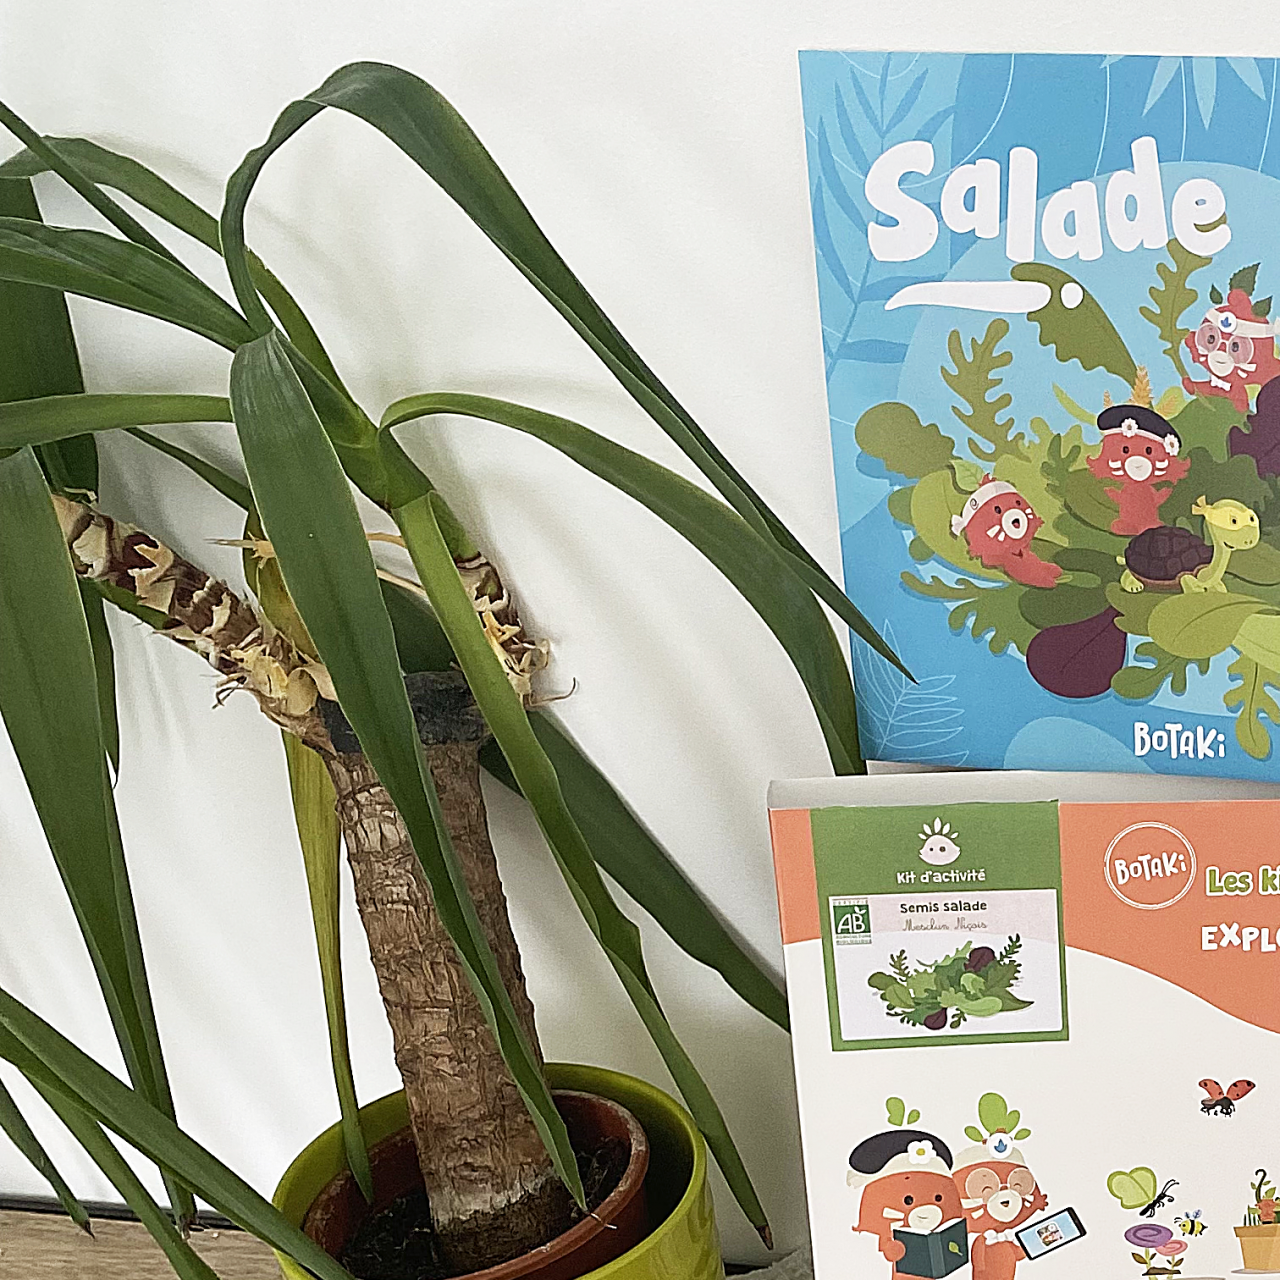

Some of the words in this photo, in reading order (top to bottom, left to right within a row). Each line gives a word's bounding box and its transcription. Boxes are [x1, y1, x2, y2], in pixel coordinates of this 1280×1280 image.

[864, 136, 1232, 262] Salade
[896, 871, 916, 884] Kit
[920, 868, 986, 883] d'activité
[1206, 867, 1252, 895] Les
[900, 901, 940, 913] Semis
[943, 900, 987, 912] salade
[837, 912, 866, 933] AB
[902, 918, 950, 931] Mesclun
